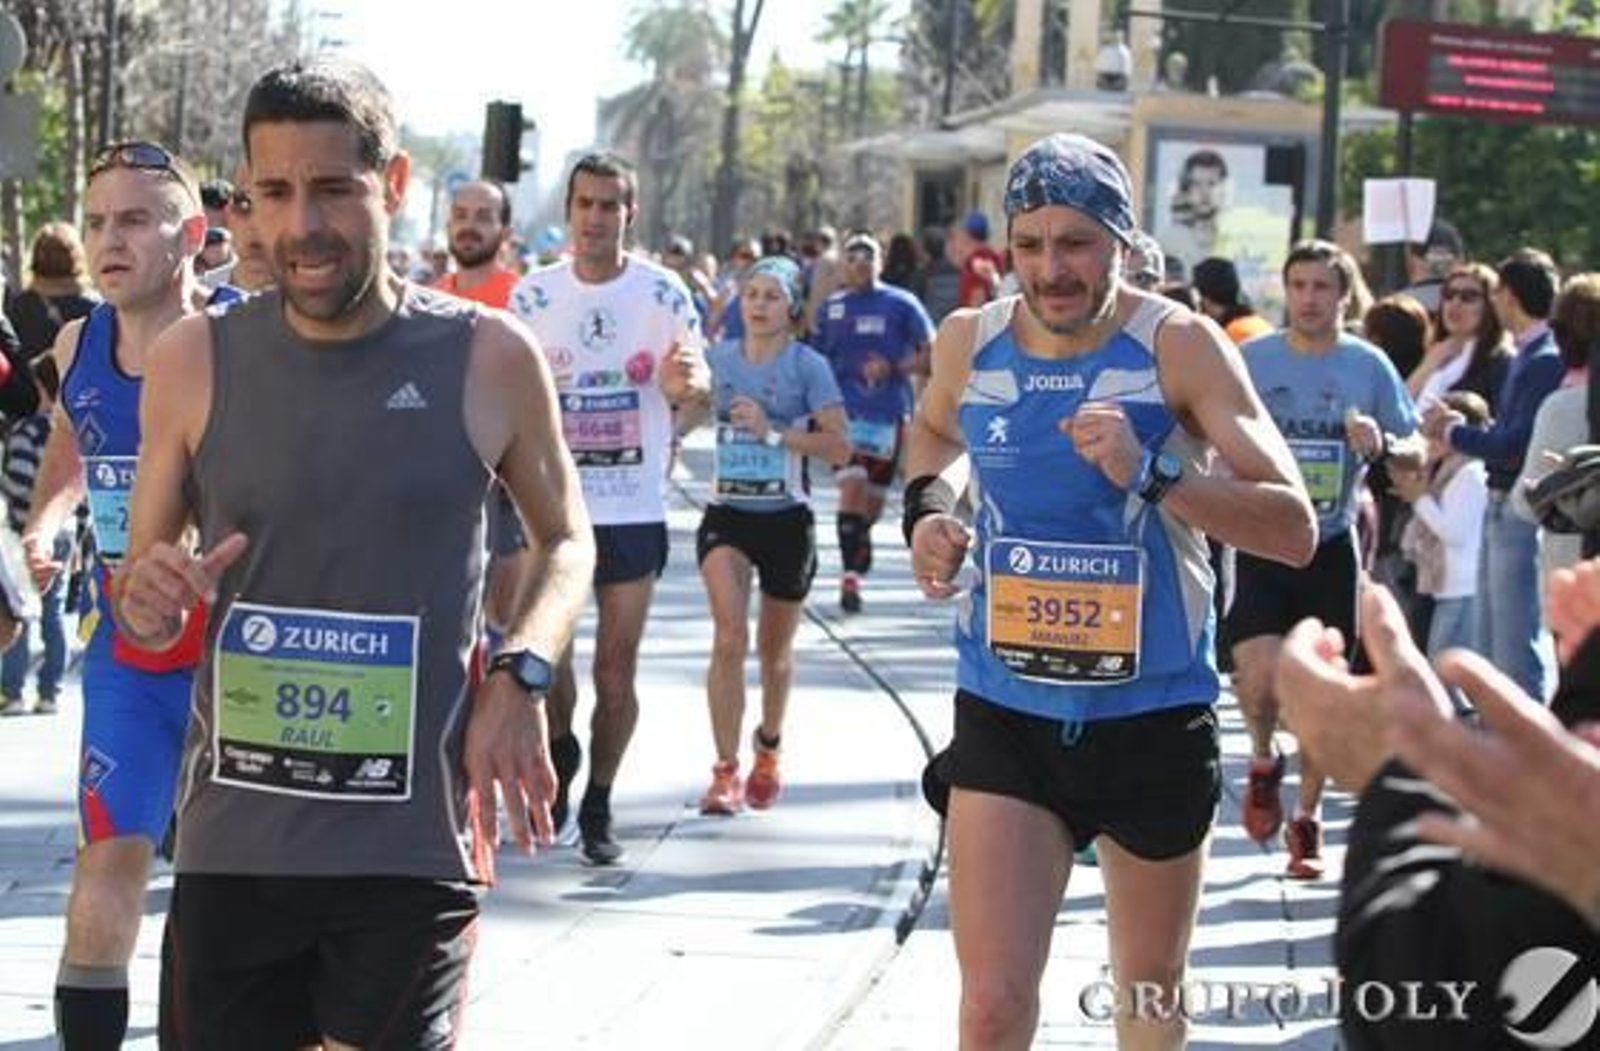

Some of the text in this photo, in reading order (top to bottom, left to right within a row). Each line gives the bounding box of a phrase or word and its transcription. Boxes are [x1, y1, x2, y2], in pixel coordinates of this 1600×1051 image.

[1037, 555, 1119, 575] ZURICH
[1027, 595, 1102, 628] 3952
[282, 627, 389, 655] ZURICH
[275, 683, 353, 723] 894
[281, 727, 335, 749] RAUL
